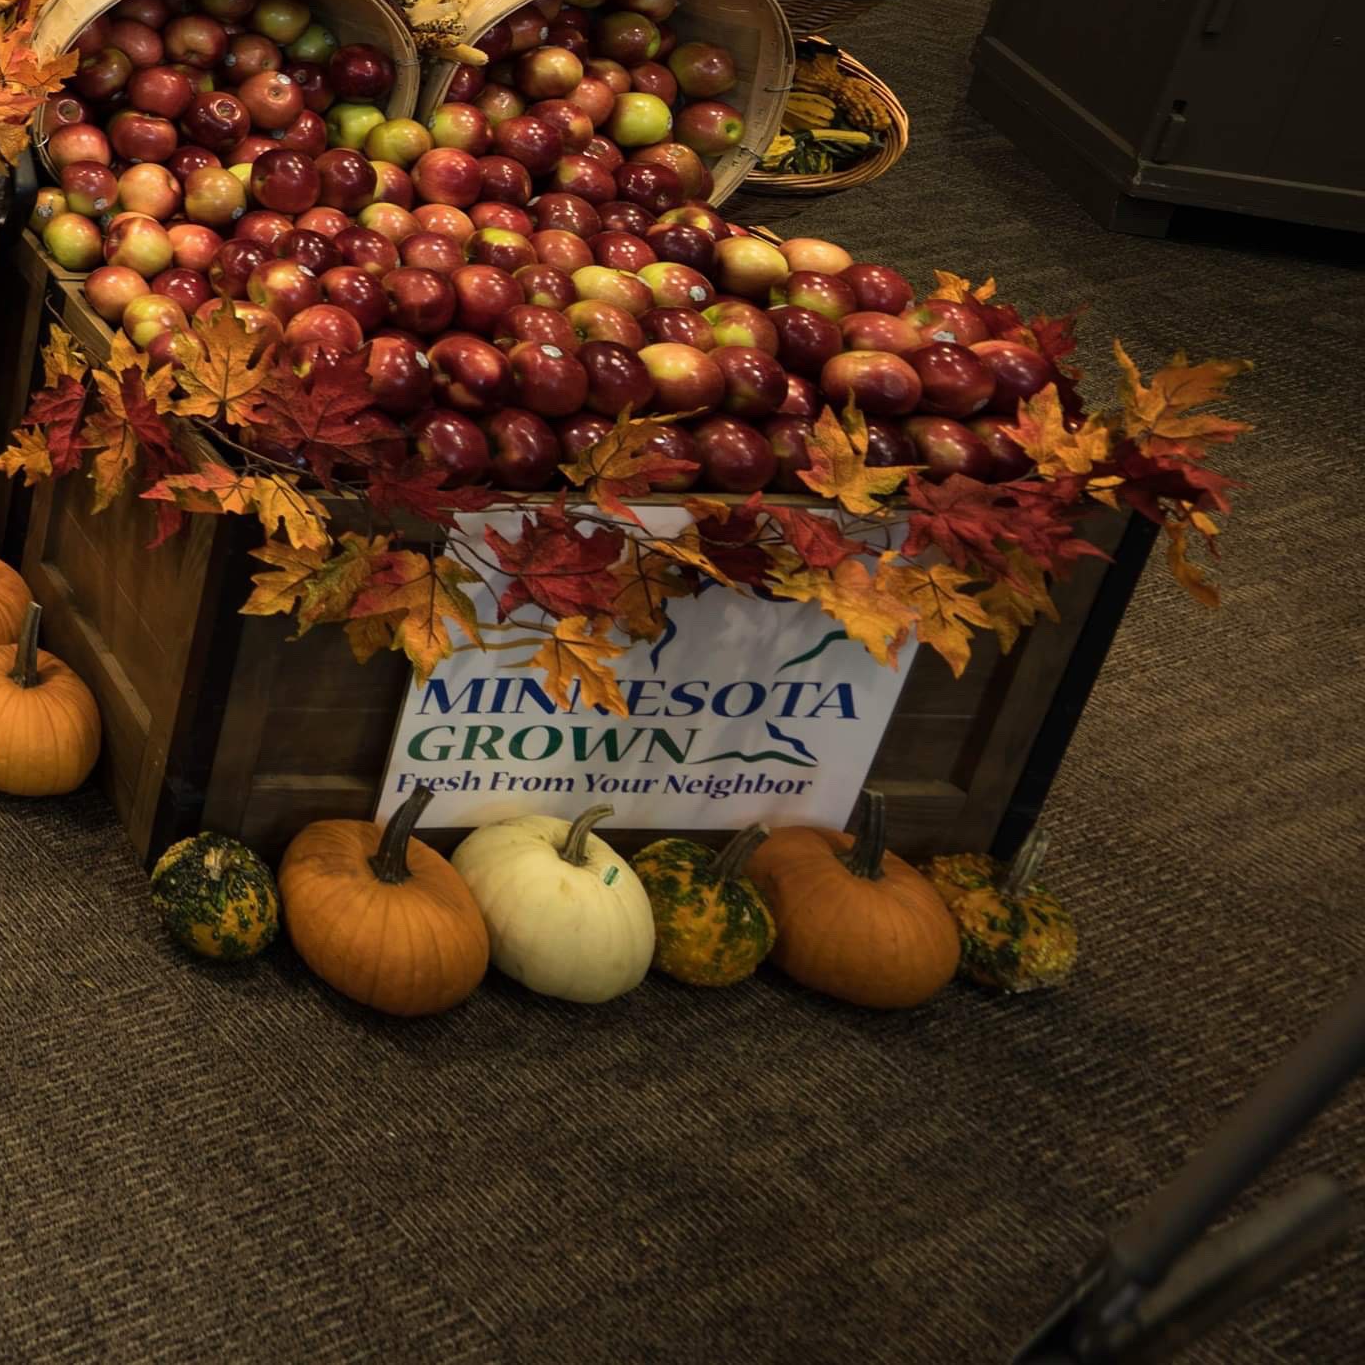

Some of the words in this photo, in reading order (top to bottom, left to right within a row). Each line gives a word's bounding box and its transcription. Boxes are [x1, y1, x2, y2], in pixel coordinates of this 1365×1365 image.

[405, 724, 703, 765] GROWN
[395, 769, 482, 795] Fresh
[488, 771, 574, 795] From
[582, 773, 659, 796] Your
[661, 773, 814, 800] Neighbor
